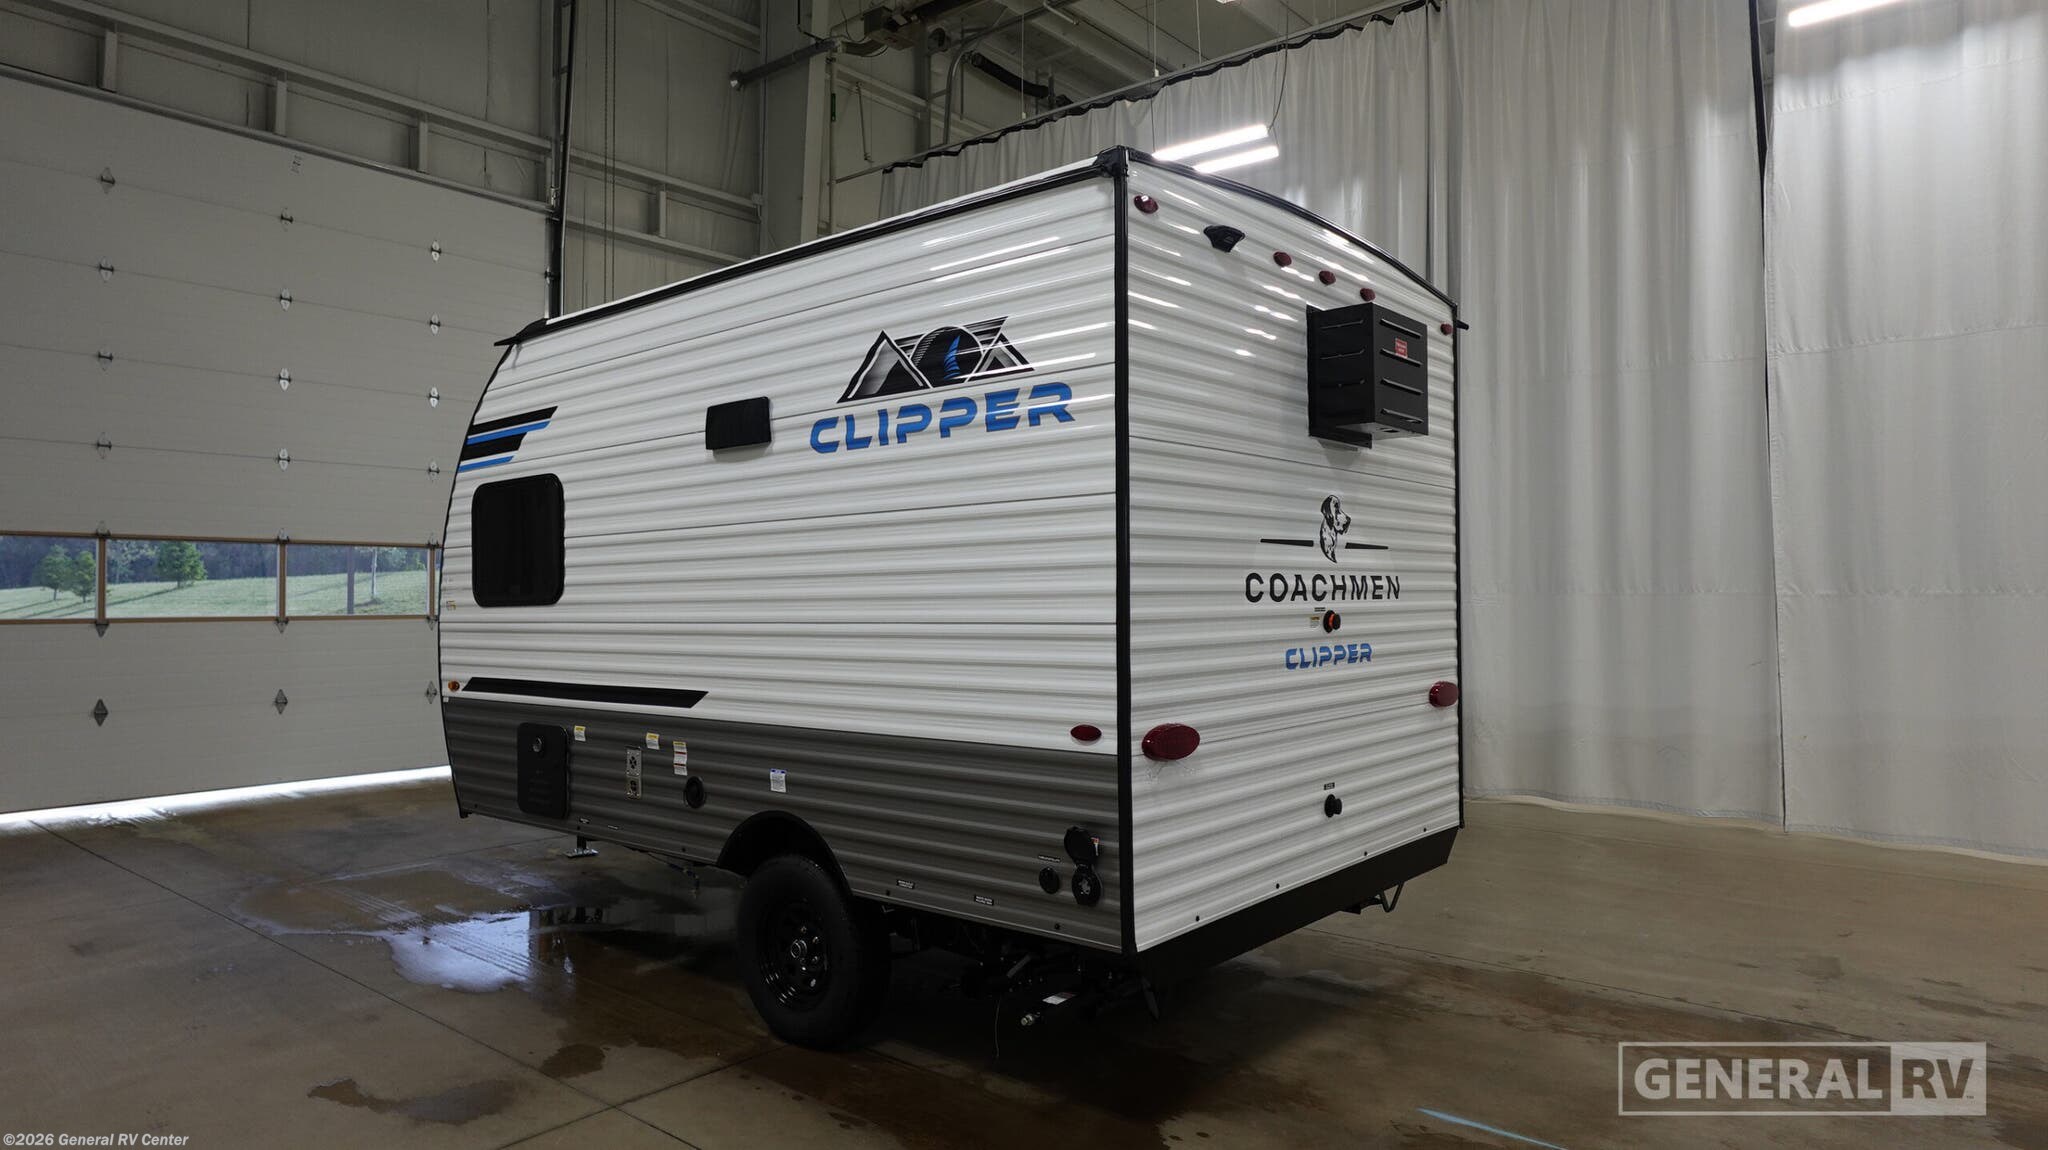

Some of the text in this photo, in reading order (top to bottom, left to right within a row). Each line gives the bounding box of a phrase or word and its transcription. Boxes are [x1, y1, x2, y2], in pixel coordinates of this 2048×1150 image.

[810, 381, 1075, 454] CLIPPER
[1245, 572, 1400, 603] COACHMEN
[1285, 642, 1373, 670] CLIPPER
